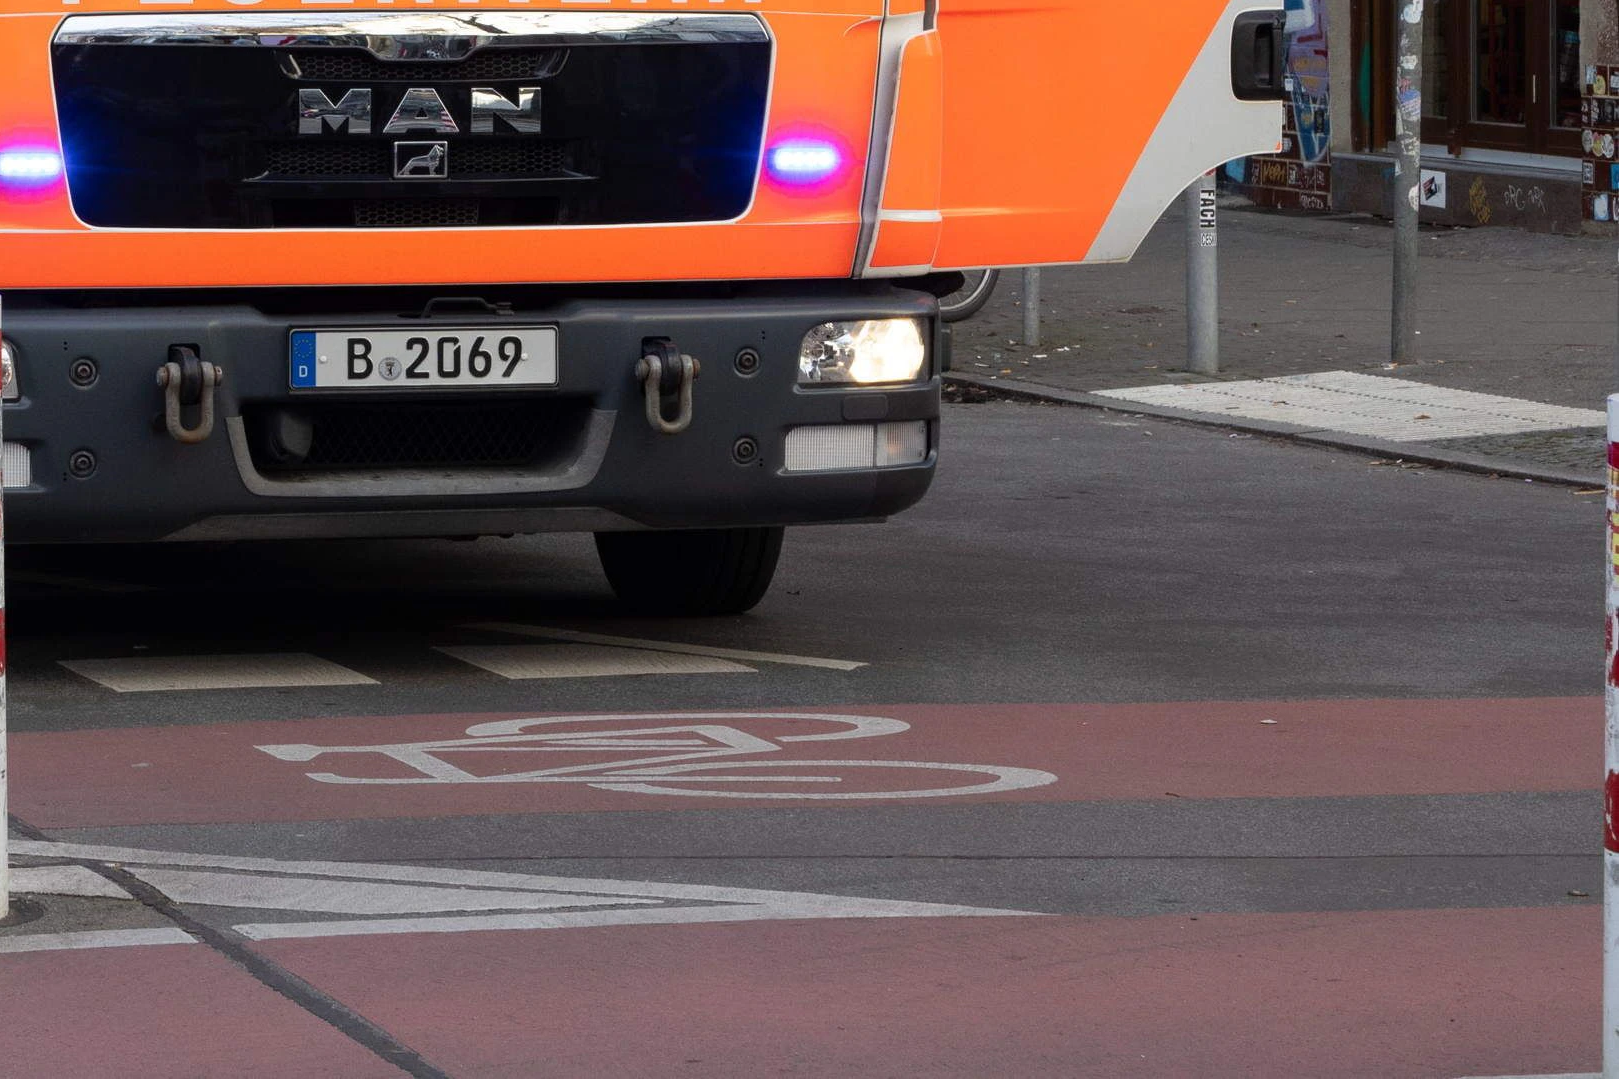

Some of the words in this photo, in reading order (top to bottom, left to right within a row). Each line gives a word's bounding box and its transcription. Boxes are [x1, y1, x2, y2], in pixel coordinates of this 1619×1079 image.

[299, 87, 541, 134] MAN
[1200, 189, 1215, 228] FACH
[298, 365, 308, 378] D
[347, 337, 374, 380] B
[405, 336, 523, 379] 2069
